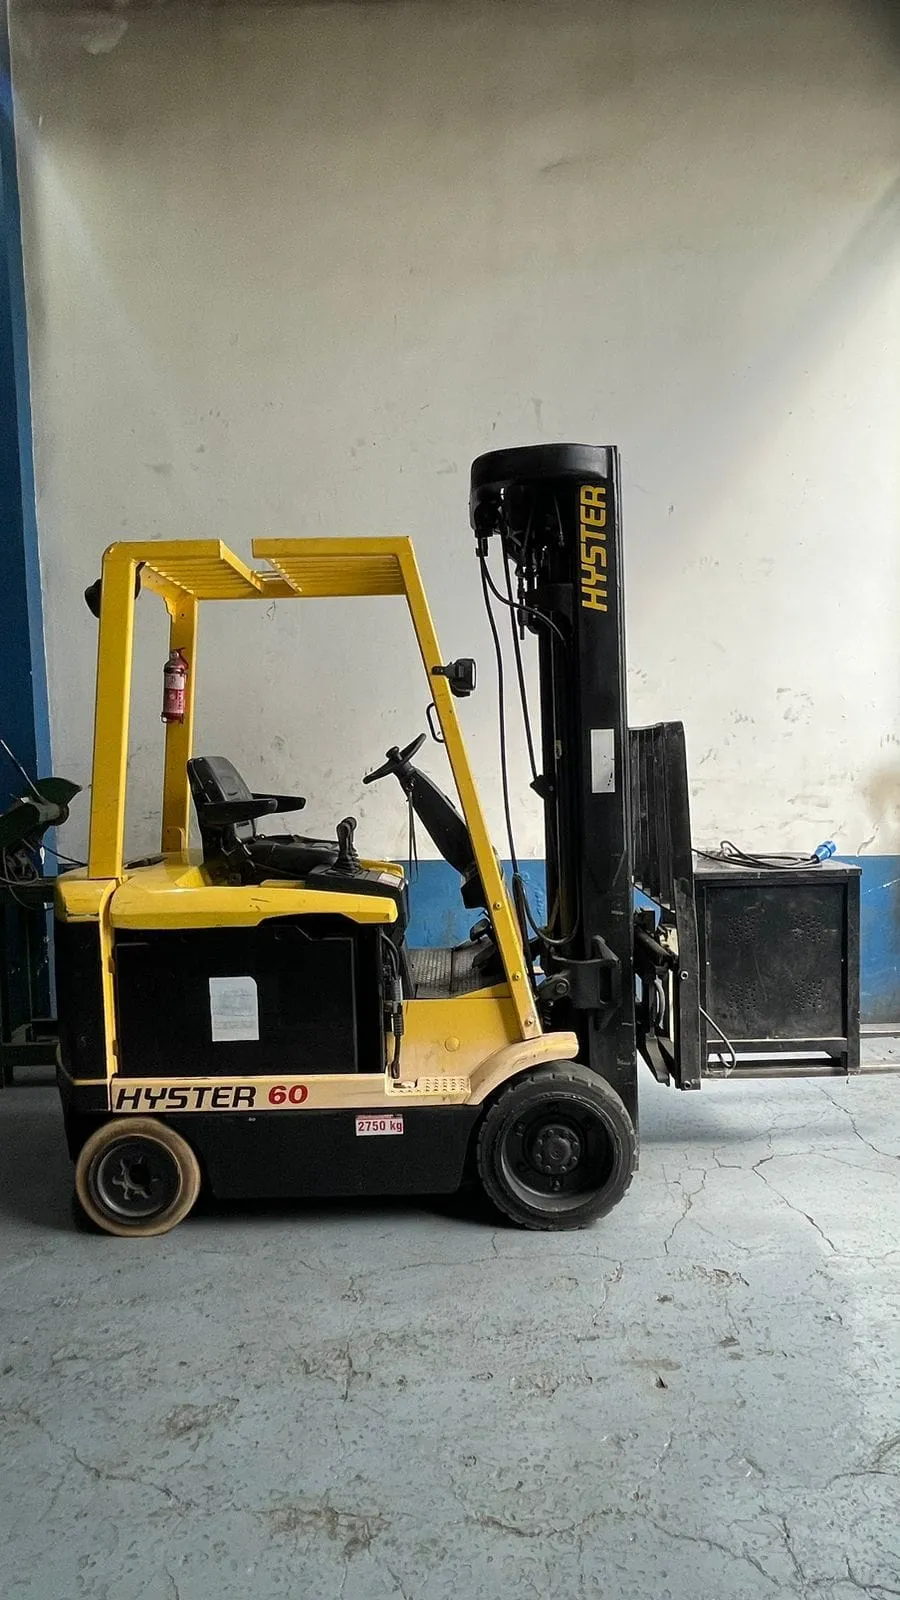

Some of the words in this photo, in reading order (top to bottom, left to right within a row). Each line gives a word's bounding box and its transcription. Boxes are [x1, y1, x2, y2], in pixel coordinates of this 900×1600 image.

[580, 484, 608, 612] HYSTER
[115, 1086, 257, 1110] HYSTER
[268, 1084, 309, 1105] 60
[358, 1121, 386, 1132] 2750
[390, 1120, 403, 1133] kg
